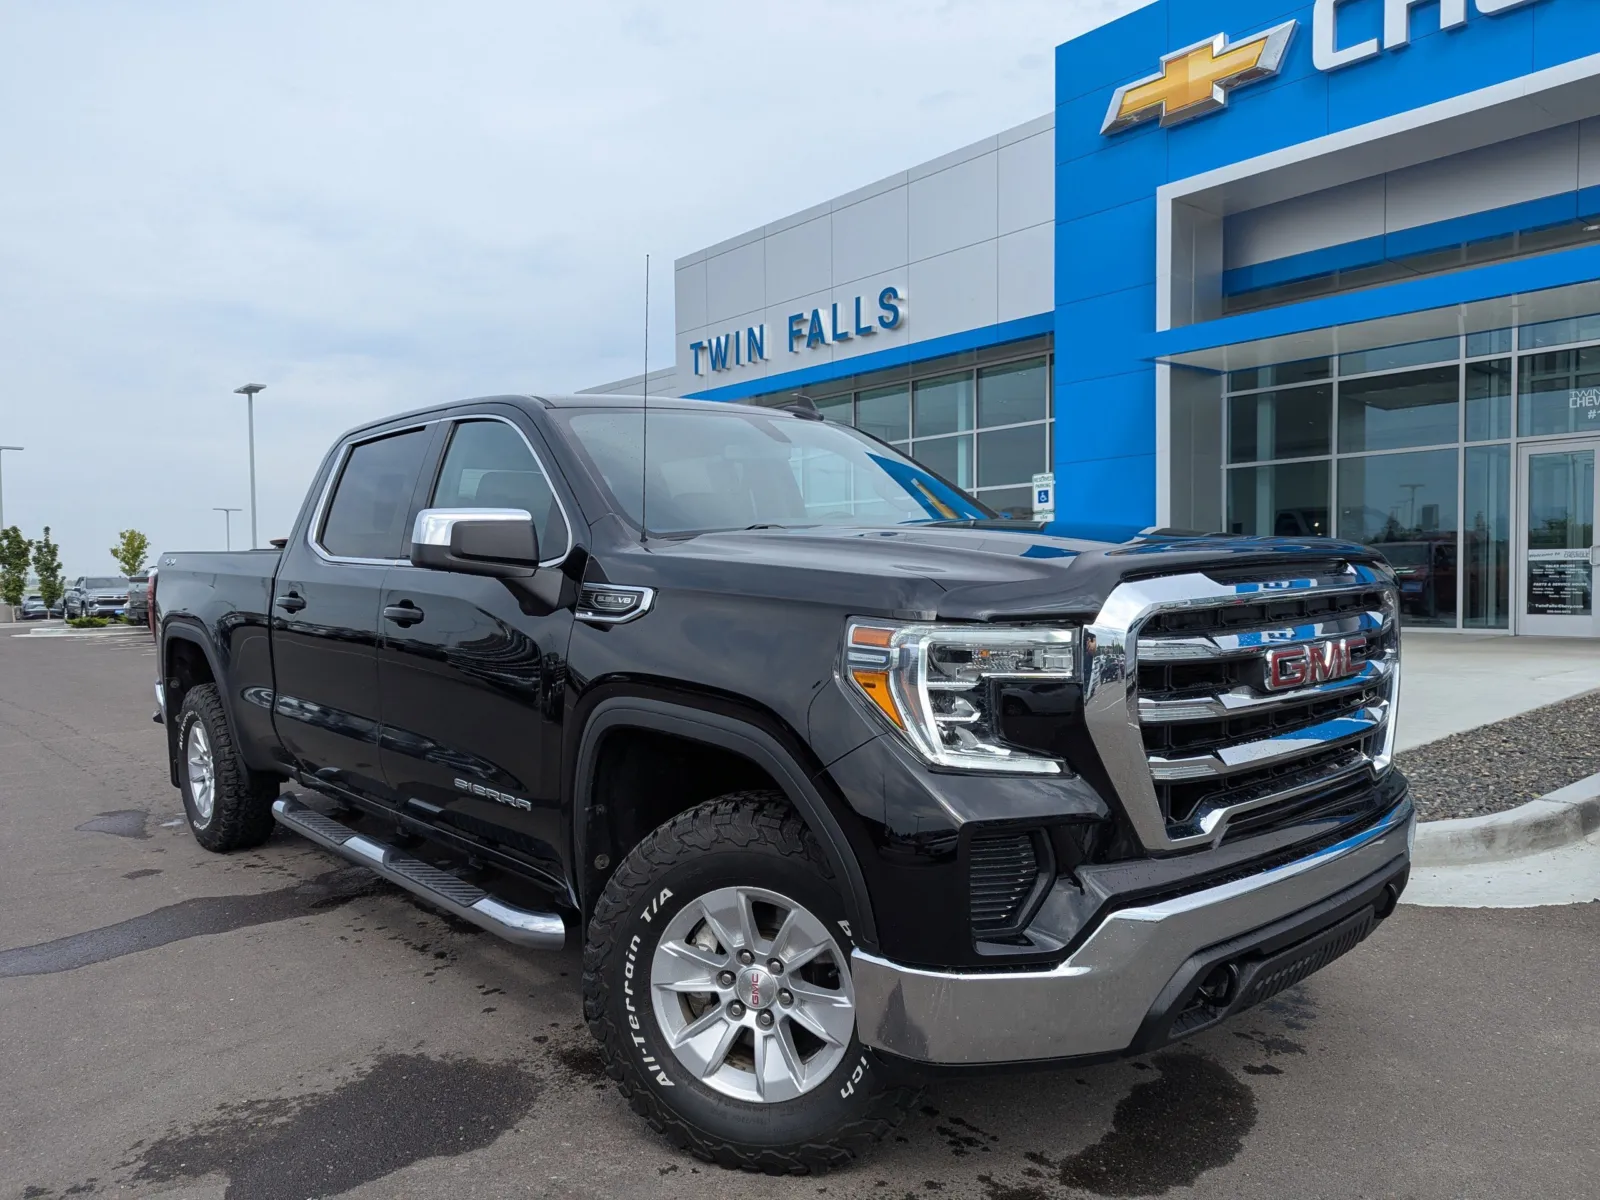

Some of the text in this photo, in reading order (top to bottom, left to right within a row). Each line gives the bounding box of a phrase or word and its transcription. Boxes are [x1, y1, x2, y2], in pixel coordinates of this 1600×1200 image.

[690, 286, 903, 376] TWIN FALLS
[618, 596, 632, 604] V8
[1264, 637, 1367, 691] GMC
[453, 778, 532, 812] SIERRA
[623, 887, 675, 1088] All-Terrain T/A
[751, 973, 760, 1006] GMC
